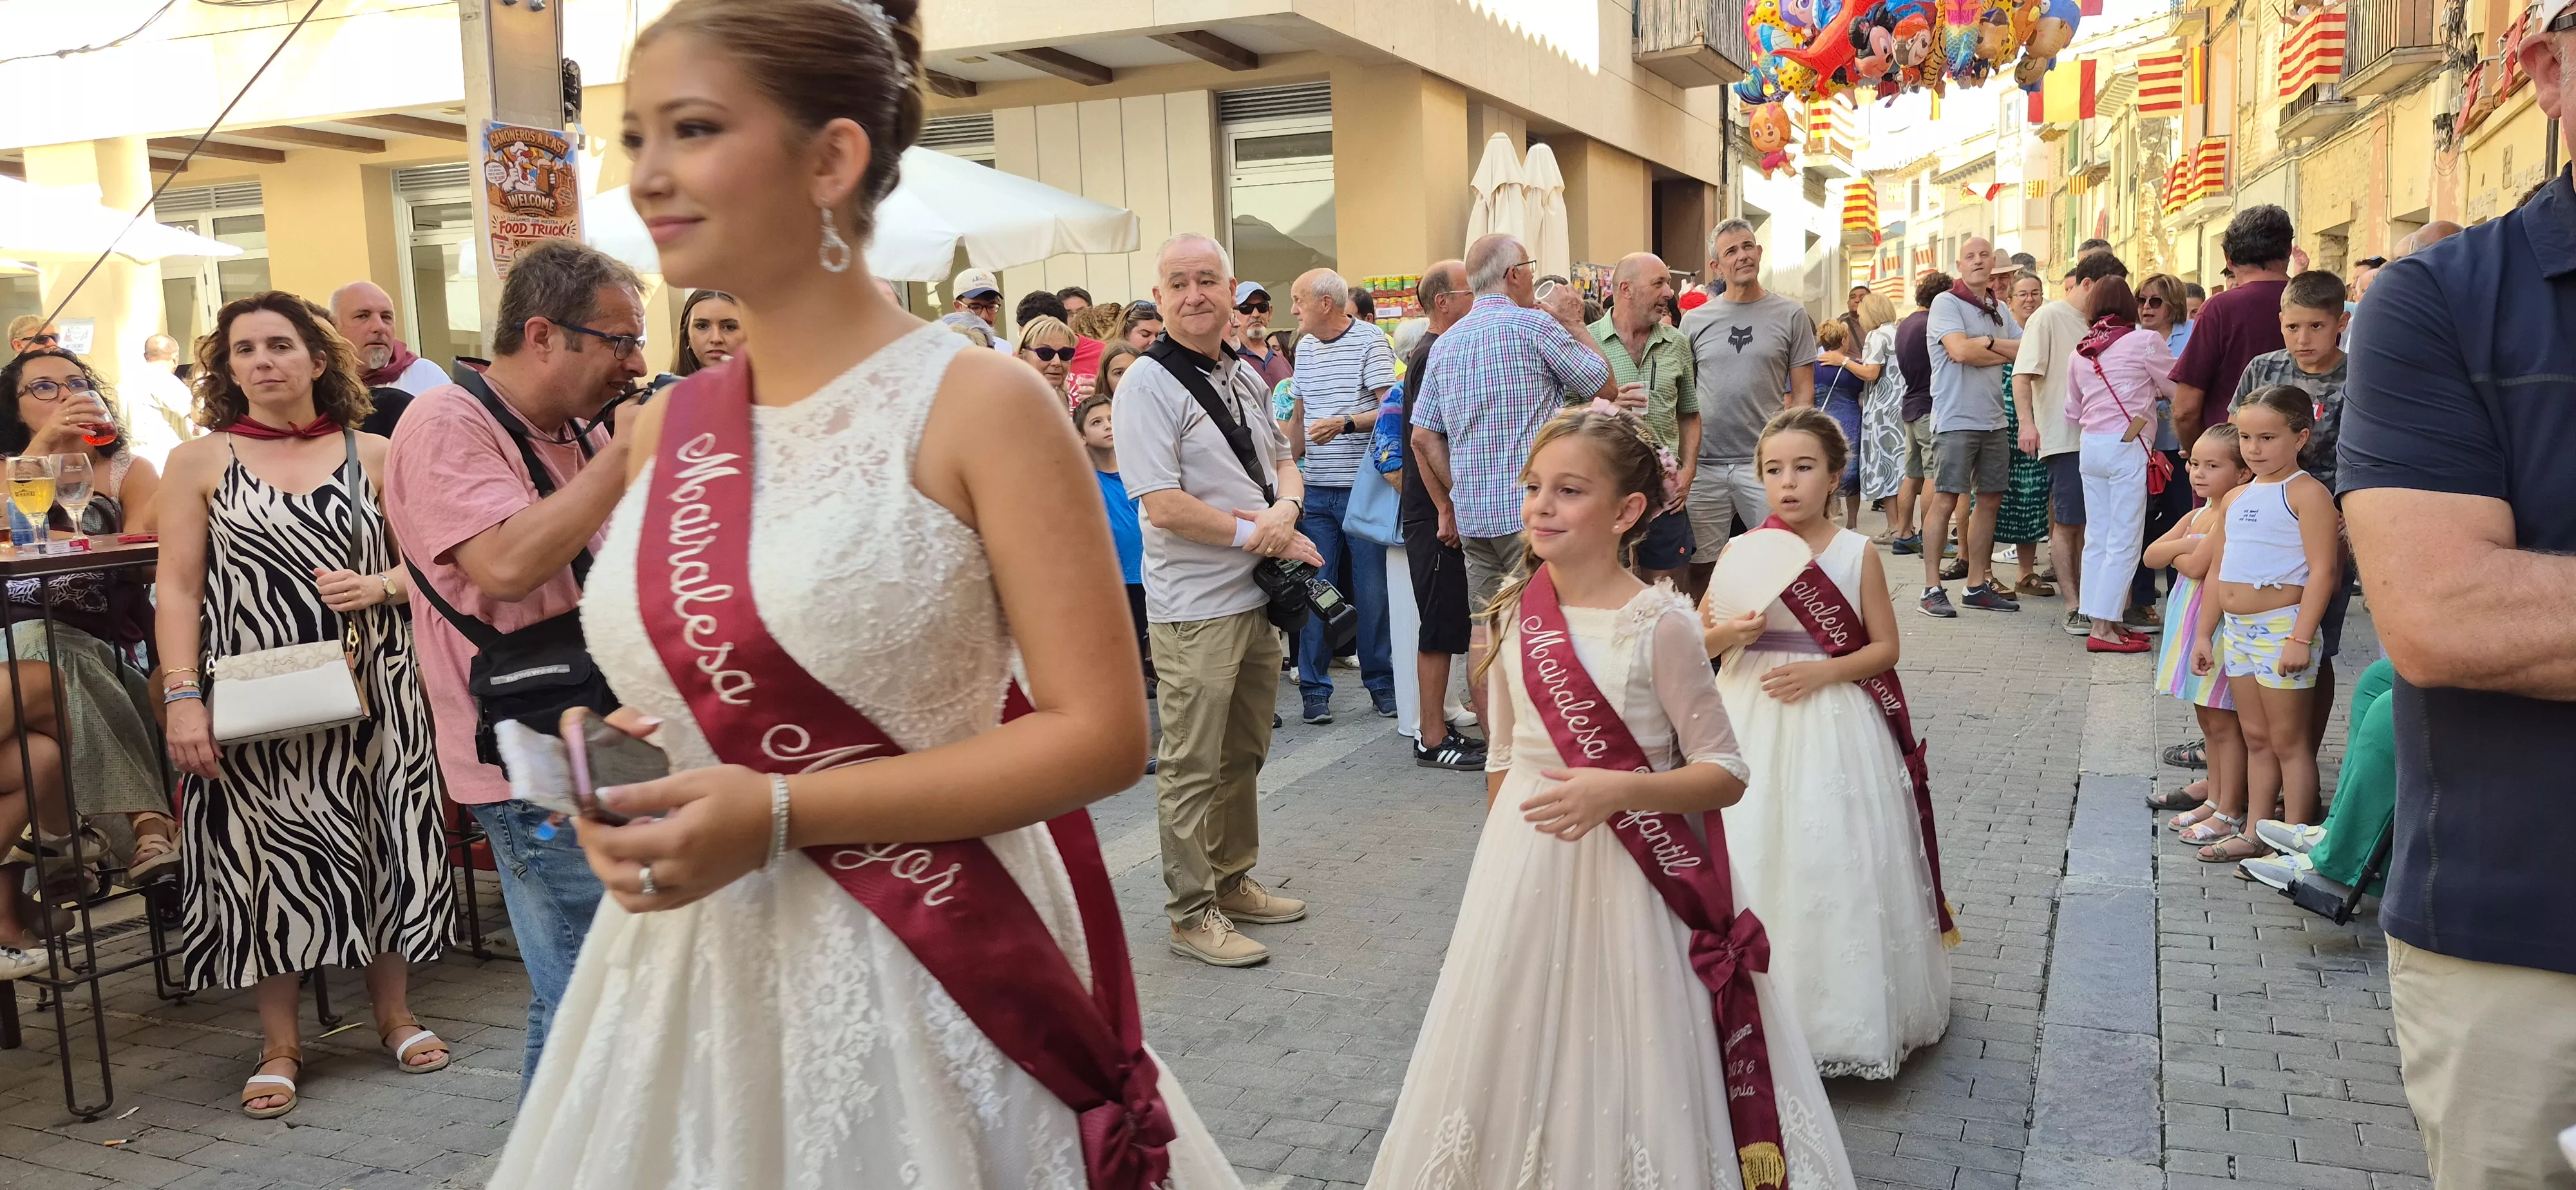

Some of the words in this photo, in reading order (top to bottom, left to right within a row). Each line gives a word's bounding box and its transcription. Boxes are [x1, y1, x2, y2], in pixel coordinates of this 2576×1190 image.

[490, 129, 536, 147] CAÑONEROS
[538, 133, 544, 144] A
[545, 135, 567, 155] L'AST
[507, 193, 556, 212] WELCOME
[499, 220, 528, 234] FOOD
[530, 223, 571, 237] TRUCK!
[498, 245, 506, 254] 7
[665, 432, 758, 706] Mairalesa
[1791, 565, 1849, 647] airalesa
[1520, 614, 1609, 760] Mairalesa
